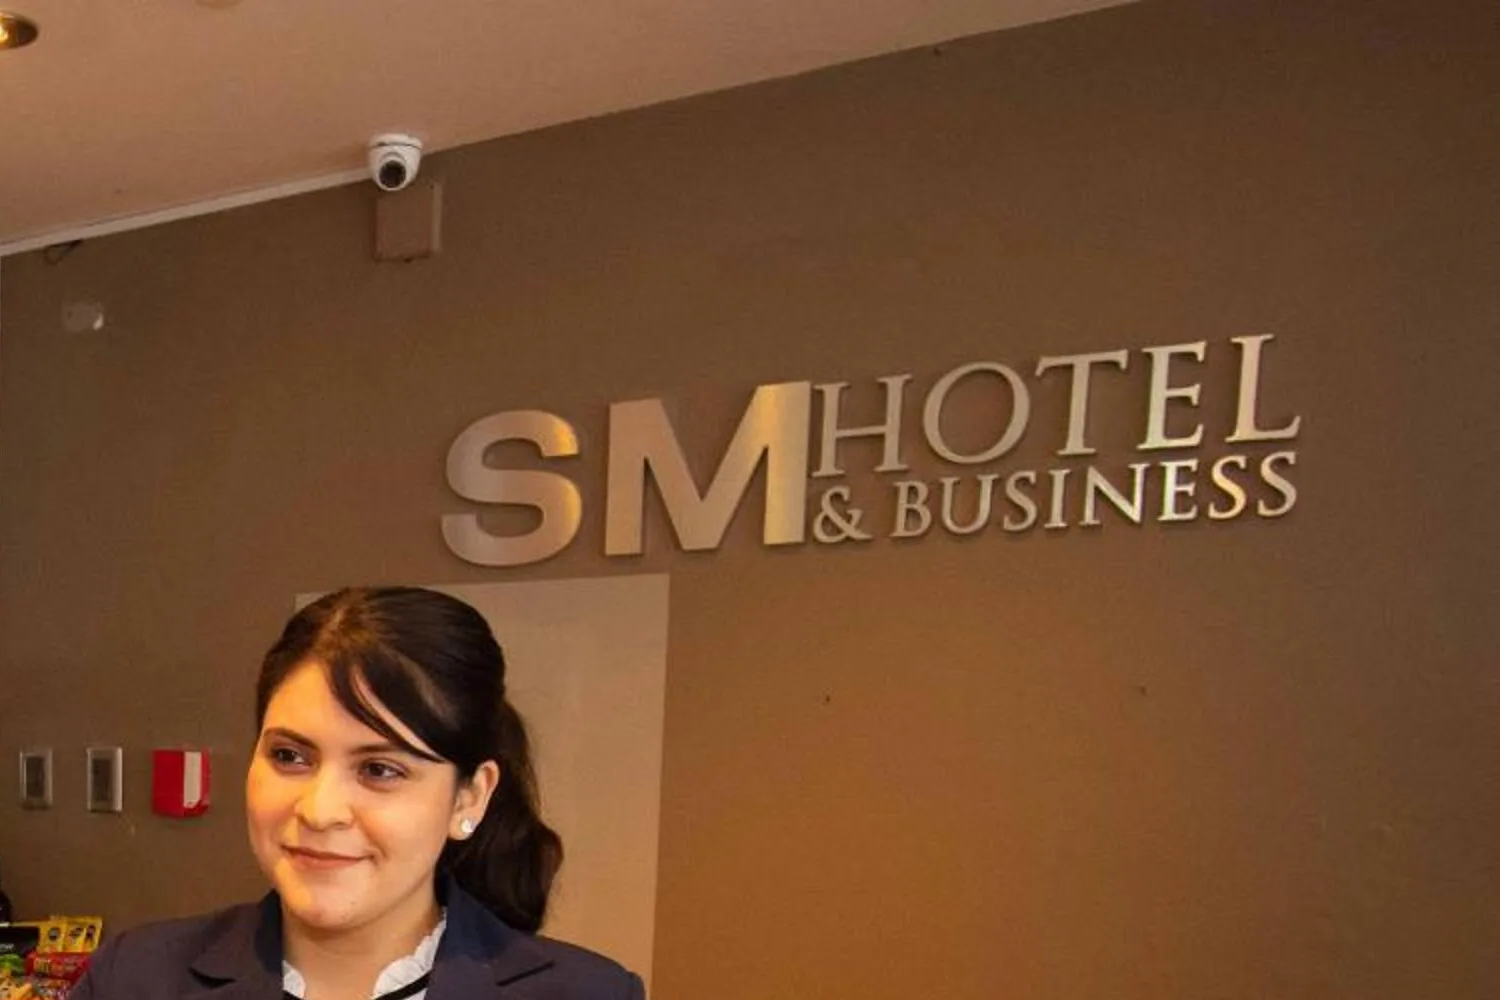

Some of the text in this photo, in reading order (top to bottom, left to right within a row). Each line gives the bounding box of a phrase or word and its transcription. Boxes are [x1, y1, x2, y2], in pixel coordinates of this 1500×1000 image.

[441, 333, 1301, 566] SM HOTEL
[812, 450, 1299, 544] & BUSINESS
